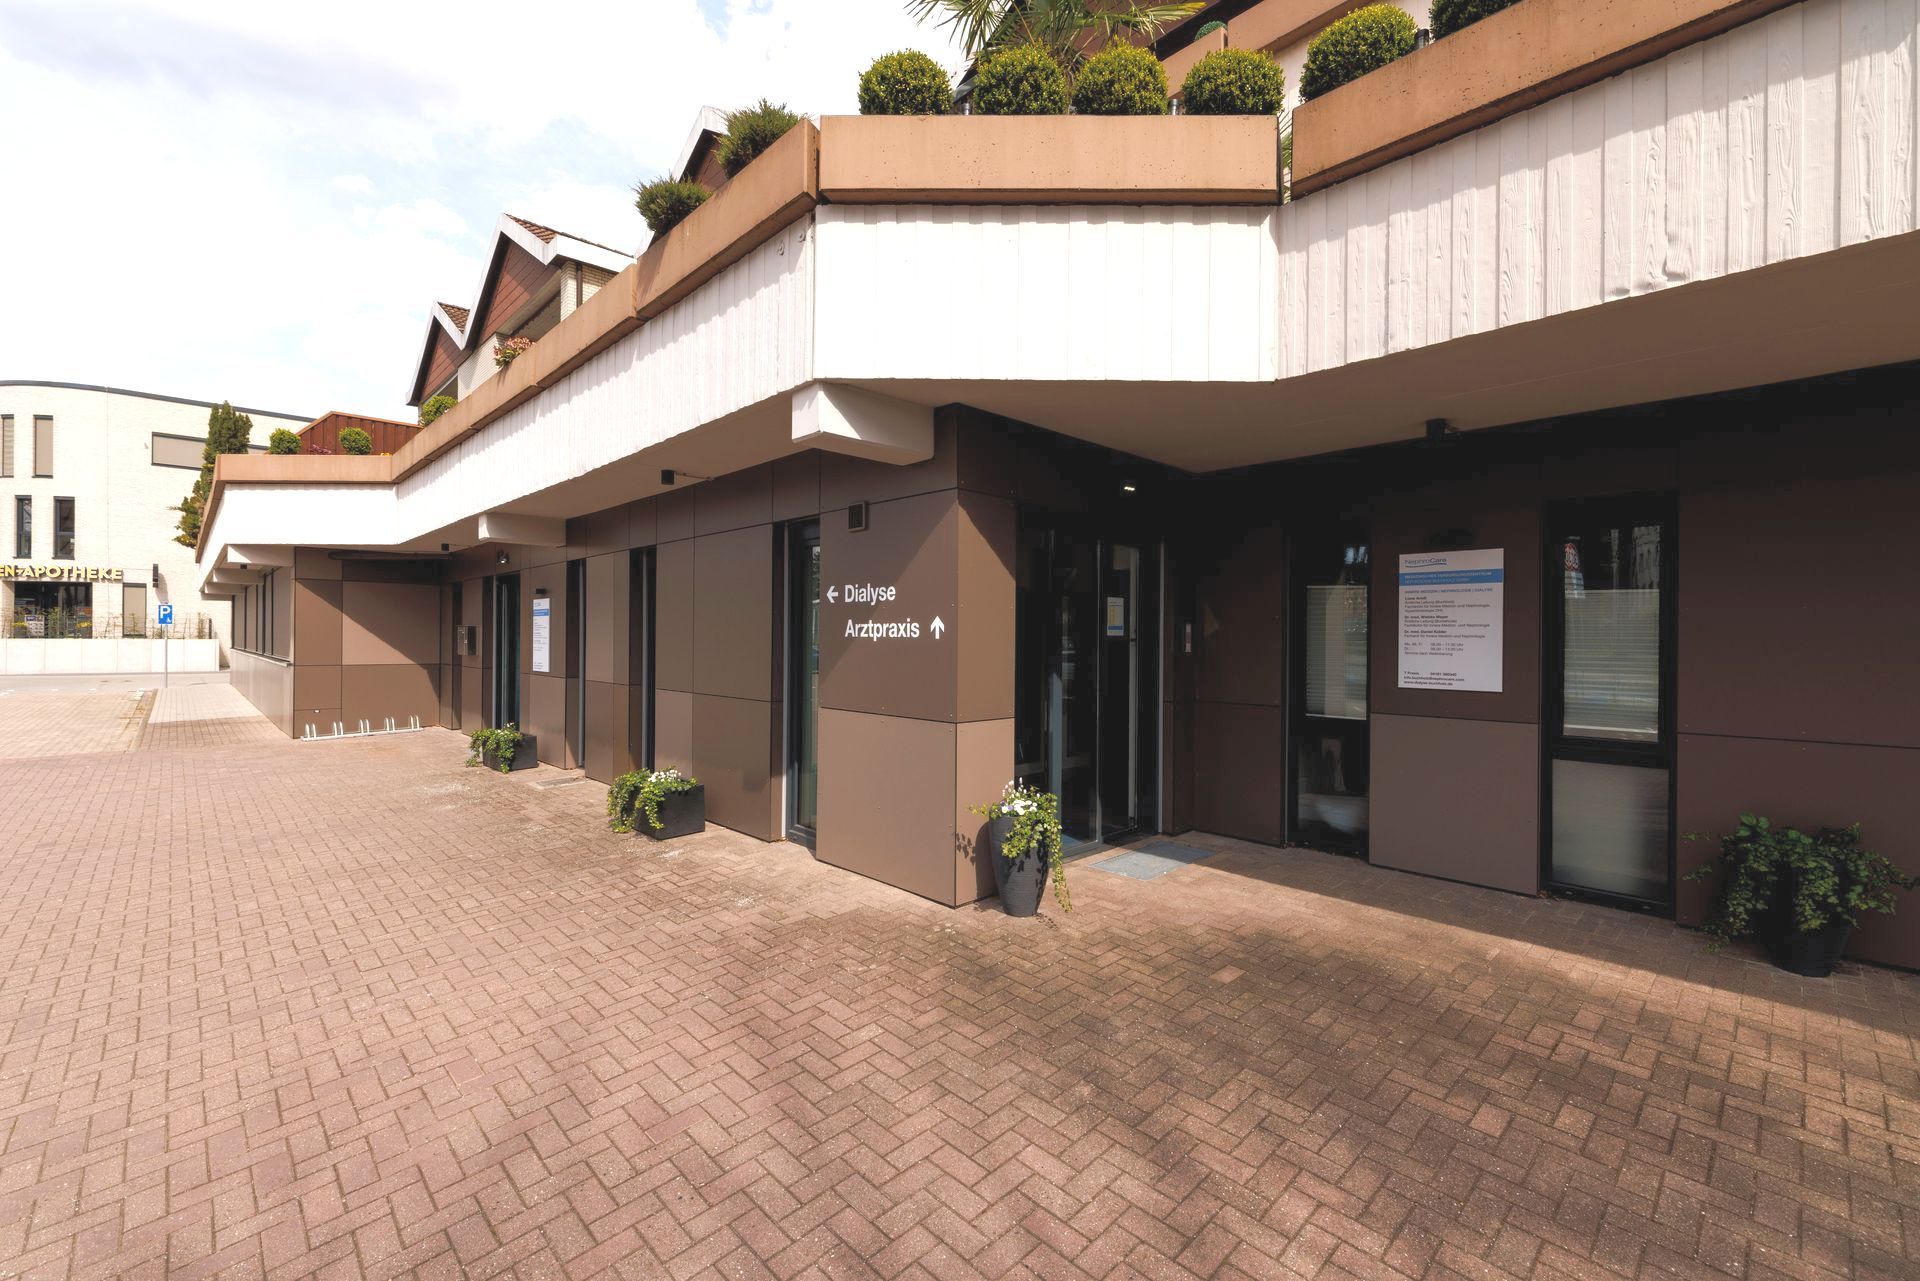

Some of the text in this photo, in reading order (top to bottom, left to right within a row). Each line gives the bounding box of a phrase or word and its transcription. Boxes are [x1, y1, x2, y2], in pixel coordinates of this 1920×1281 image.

[845, 583, 896, 606] Dialyse
[160, 606, 170, 619] P
[845, 618, 920, 642] Arztpraxis
